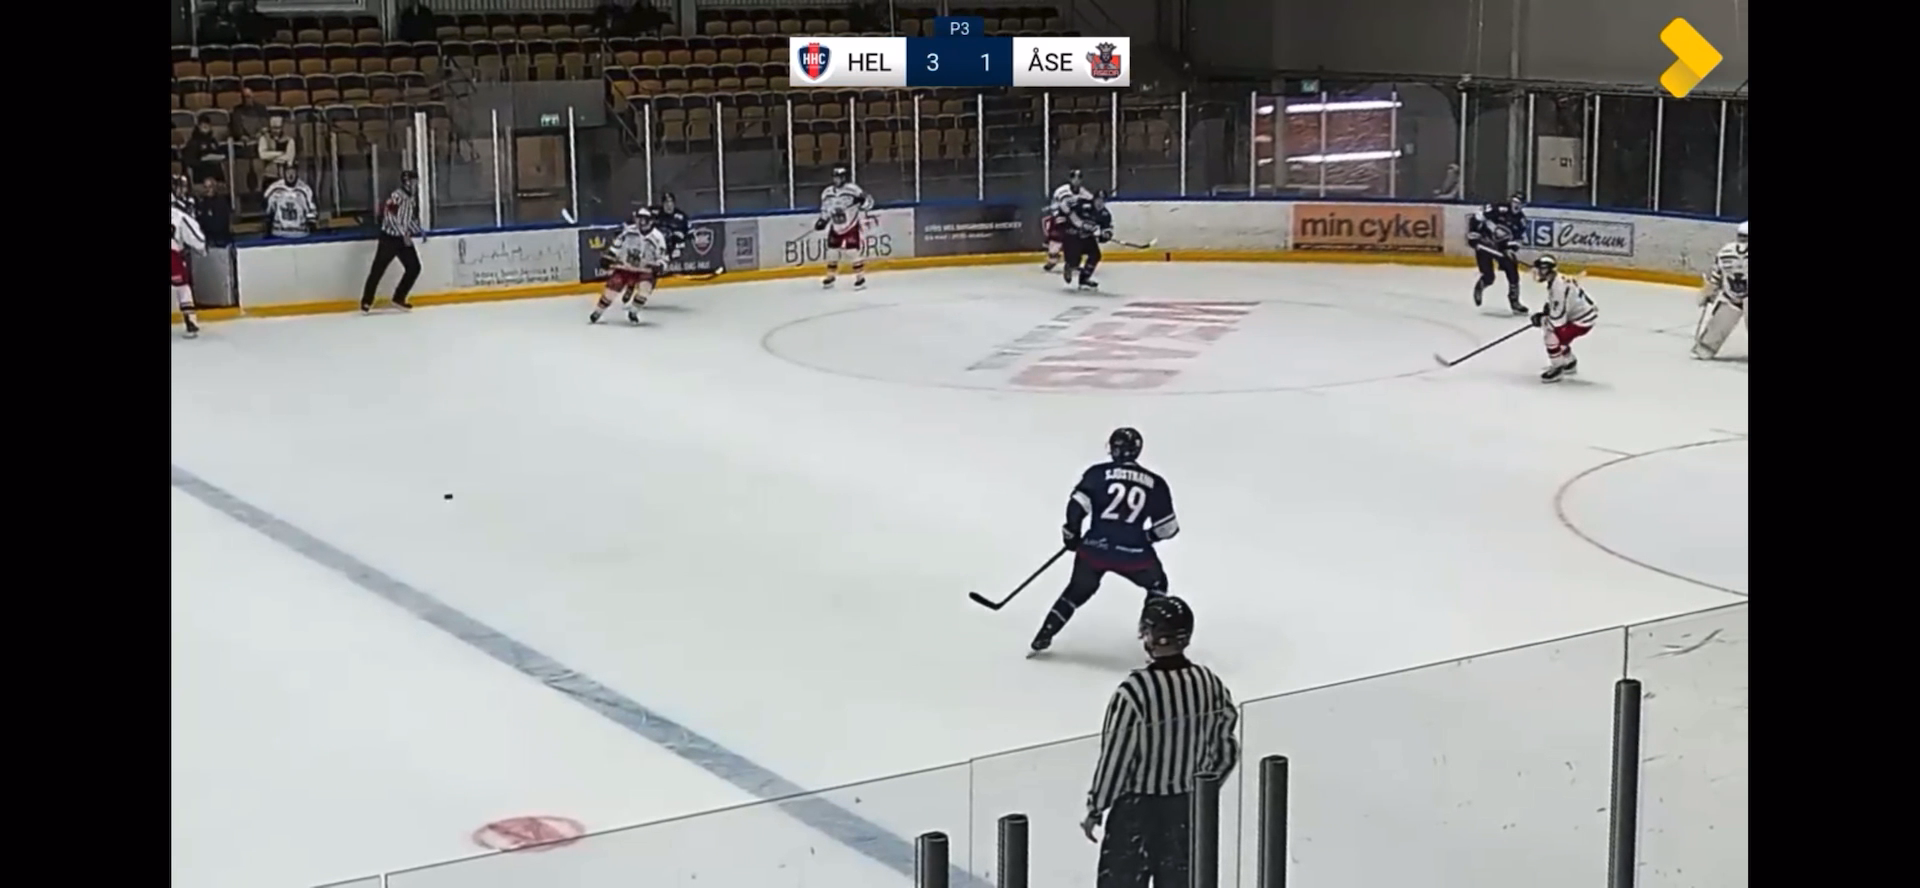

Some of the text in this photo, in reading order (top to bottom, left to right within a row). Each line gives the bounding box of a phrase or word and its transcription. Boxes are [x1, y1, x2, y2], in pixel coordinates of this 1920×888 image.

[1301, 212, 1437, 243] min cykel
[1558, 224, 1628, 248] Centrum
[785, 234, 892, 266] BJURS
[1101, 482, 1147, 524] 29
